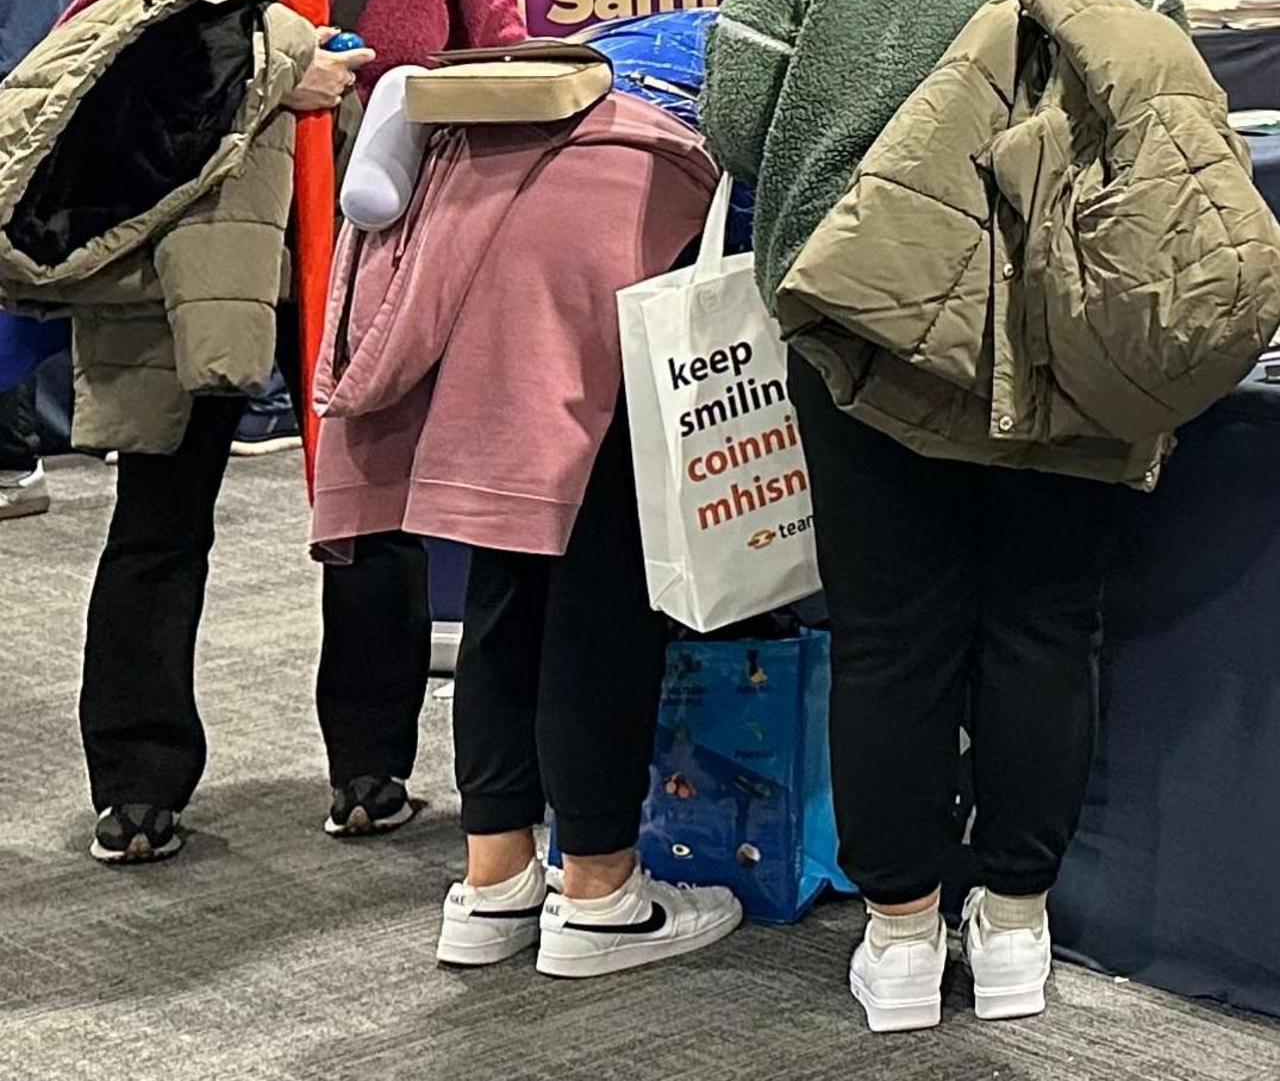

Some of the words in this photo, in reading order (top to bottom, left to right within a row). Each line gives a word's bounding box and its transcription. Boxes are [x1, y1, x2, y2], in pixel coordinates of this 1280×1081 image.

[667, 340, 753, 391] keep
[680, 378, 788, 439] smilin
[686, 415, 798, 483] coinni
[697, 468, 808, 531] mhisn
